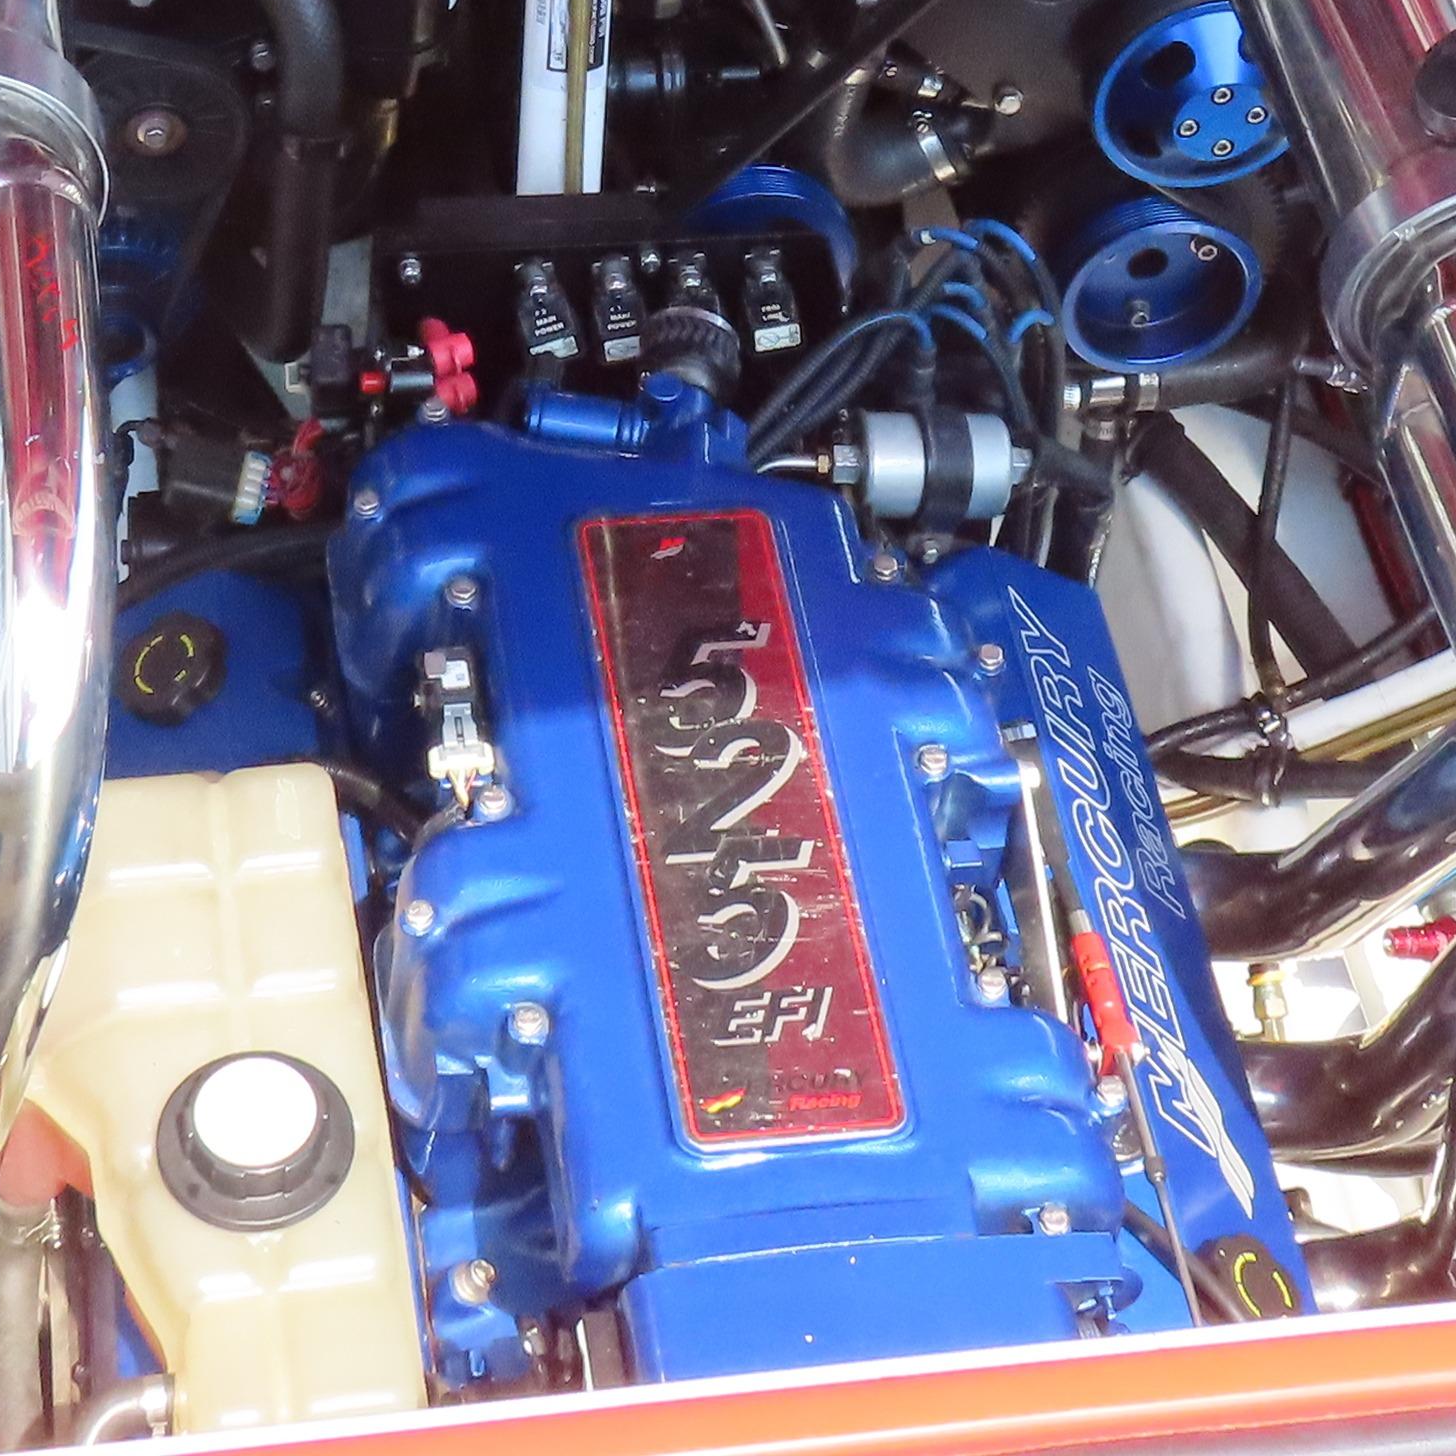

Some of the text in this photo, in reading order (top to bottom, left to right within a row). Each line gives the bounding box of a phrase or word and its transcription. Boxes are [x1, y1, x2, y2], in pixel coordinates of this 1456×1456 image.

[534, 322, 565, 337] POWER
[536, 314, 557, 327] MAIN
[1087, 665, 1186, 919] Racing
[1007, 584, 1217, 1157] MERCURY
[710, 985, 834, 1047] EFI
[787, 1092, 862, 1112] Racing
